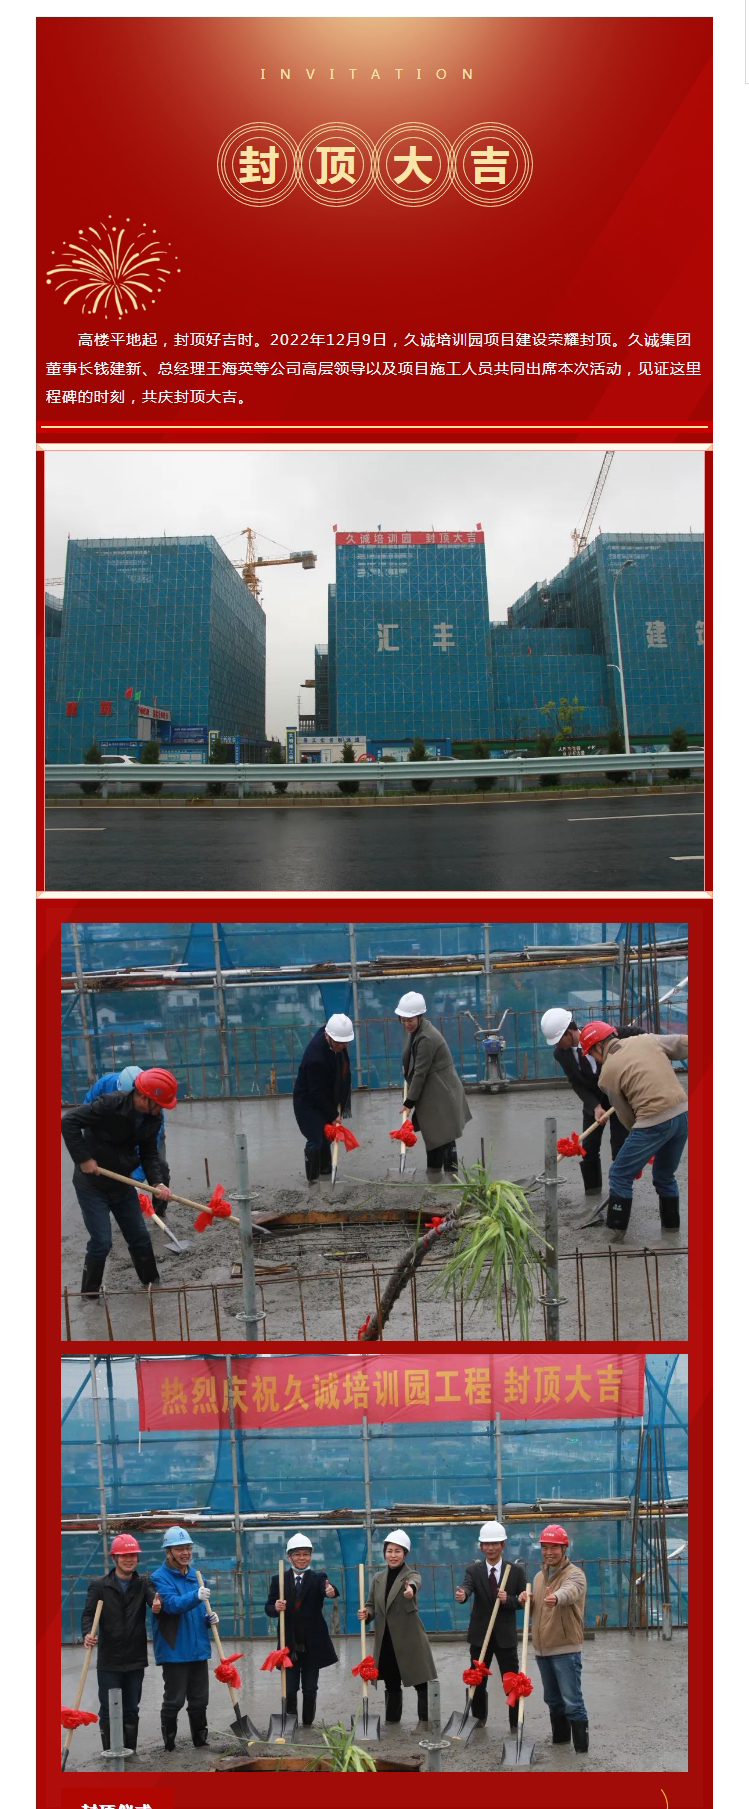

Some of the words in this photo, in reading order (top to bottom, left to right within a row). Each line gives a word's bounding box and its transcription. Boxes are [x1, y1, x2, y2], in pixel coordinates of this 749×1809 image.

[346, 533, 412, 545] 久诚培训园
[425, 532, 477, 544] 封顶大吉
[161, 1367, 492, 1414] 热烈庆祝久诚培训园工程
[504, 1363, 623, 1404] 封顶大吉
